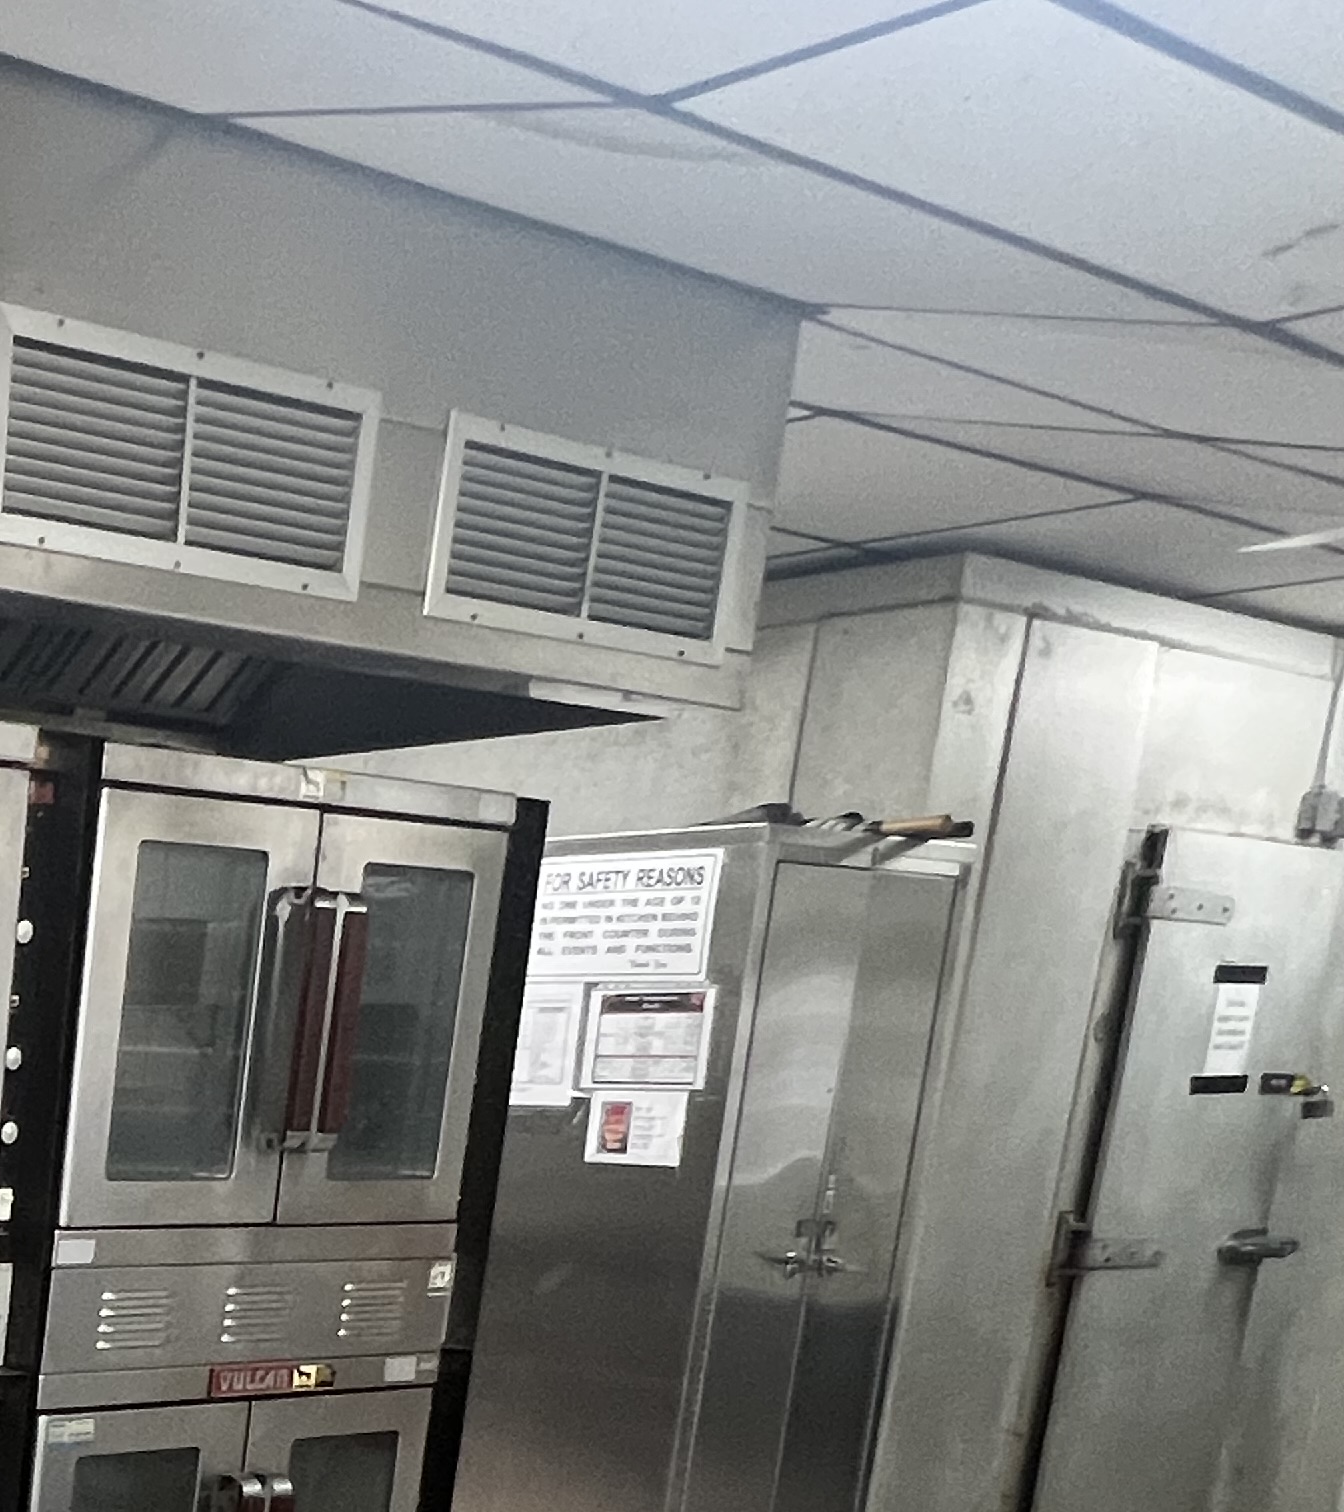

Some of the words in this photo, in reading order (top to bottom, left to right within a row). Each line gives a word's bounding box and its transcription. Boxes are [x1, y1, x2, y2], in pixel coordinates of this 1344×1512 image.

[546, 873, 572, 892] FOR
[577, 870, 631, 891] SAFETY
[635, 866, 705, 888] REASONS
[220, 1368, 289, 1392] VULCAN
